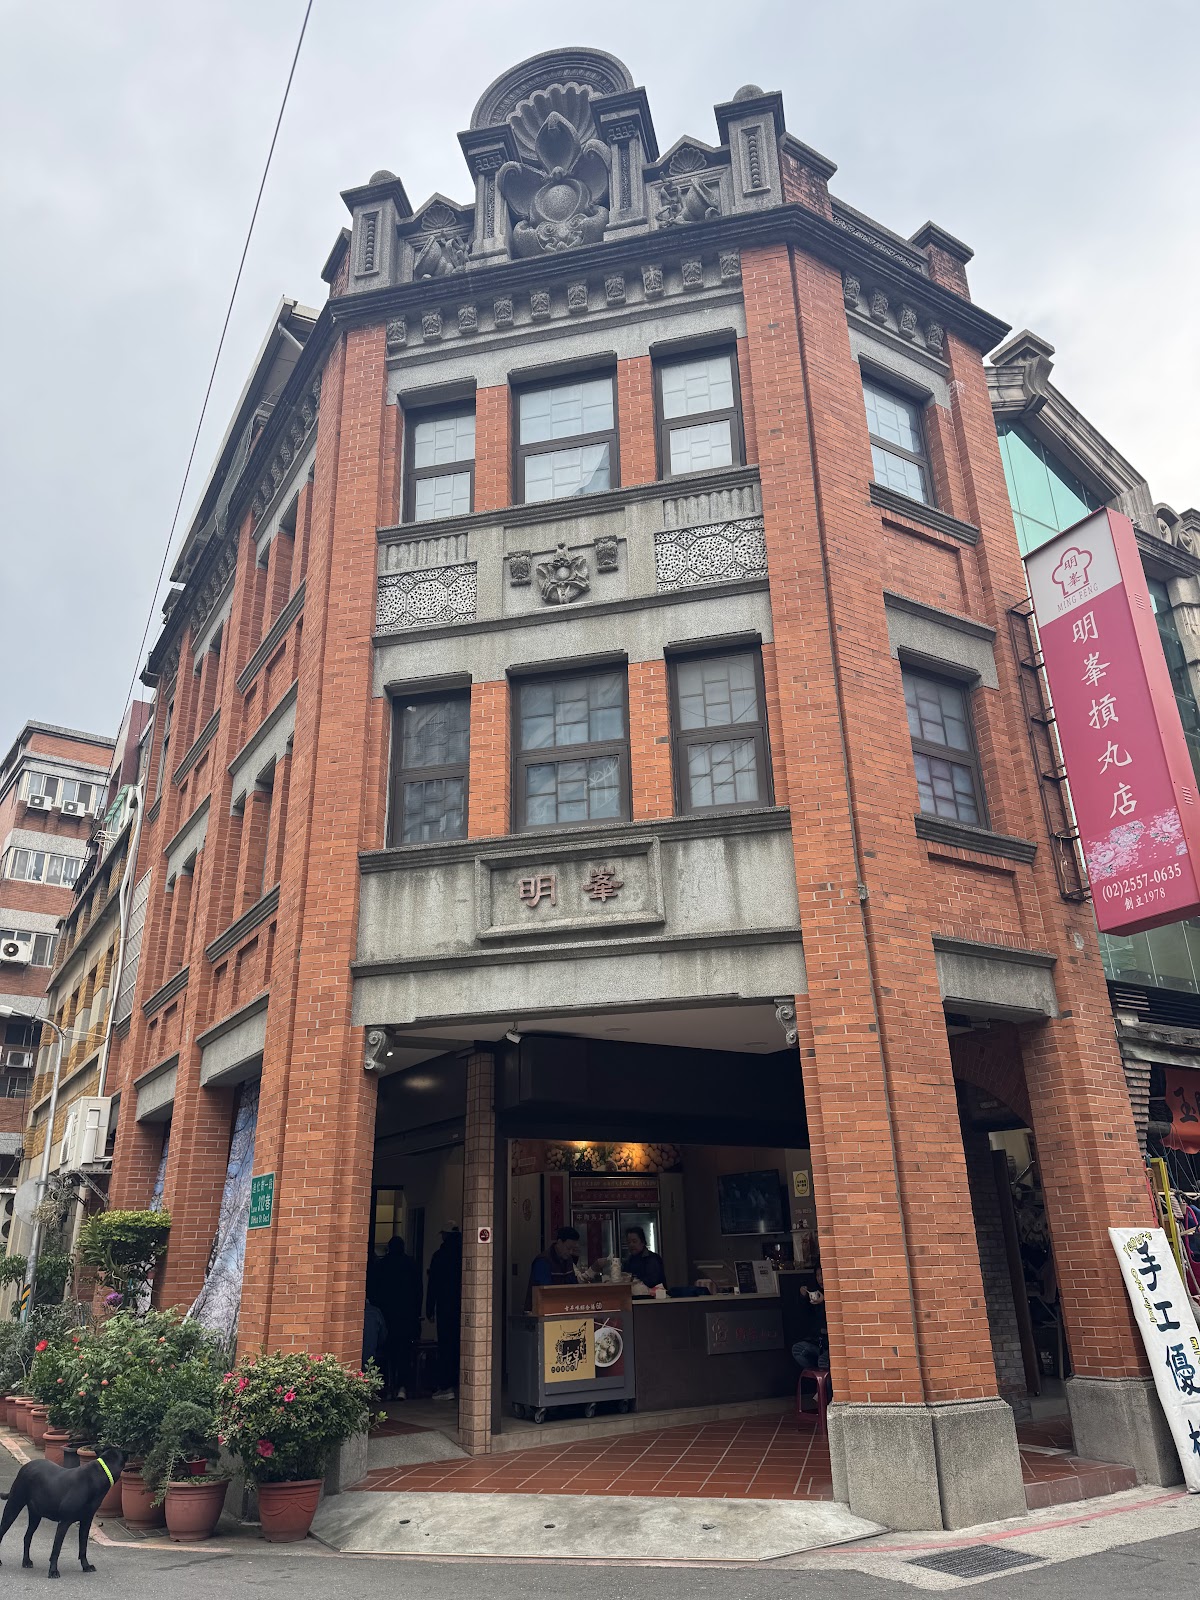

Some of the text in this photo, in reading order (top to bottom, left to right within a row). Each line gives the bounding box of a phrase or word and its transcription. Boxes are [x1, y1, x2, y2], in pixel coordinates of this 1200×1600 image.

[1057, 582, 1099, 612] MING FENG
[1102, 863, 1182, 903] (02)2557-0635
